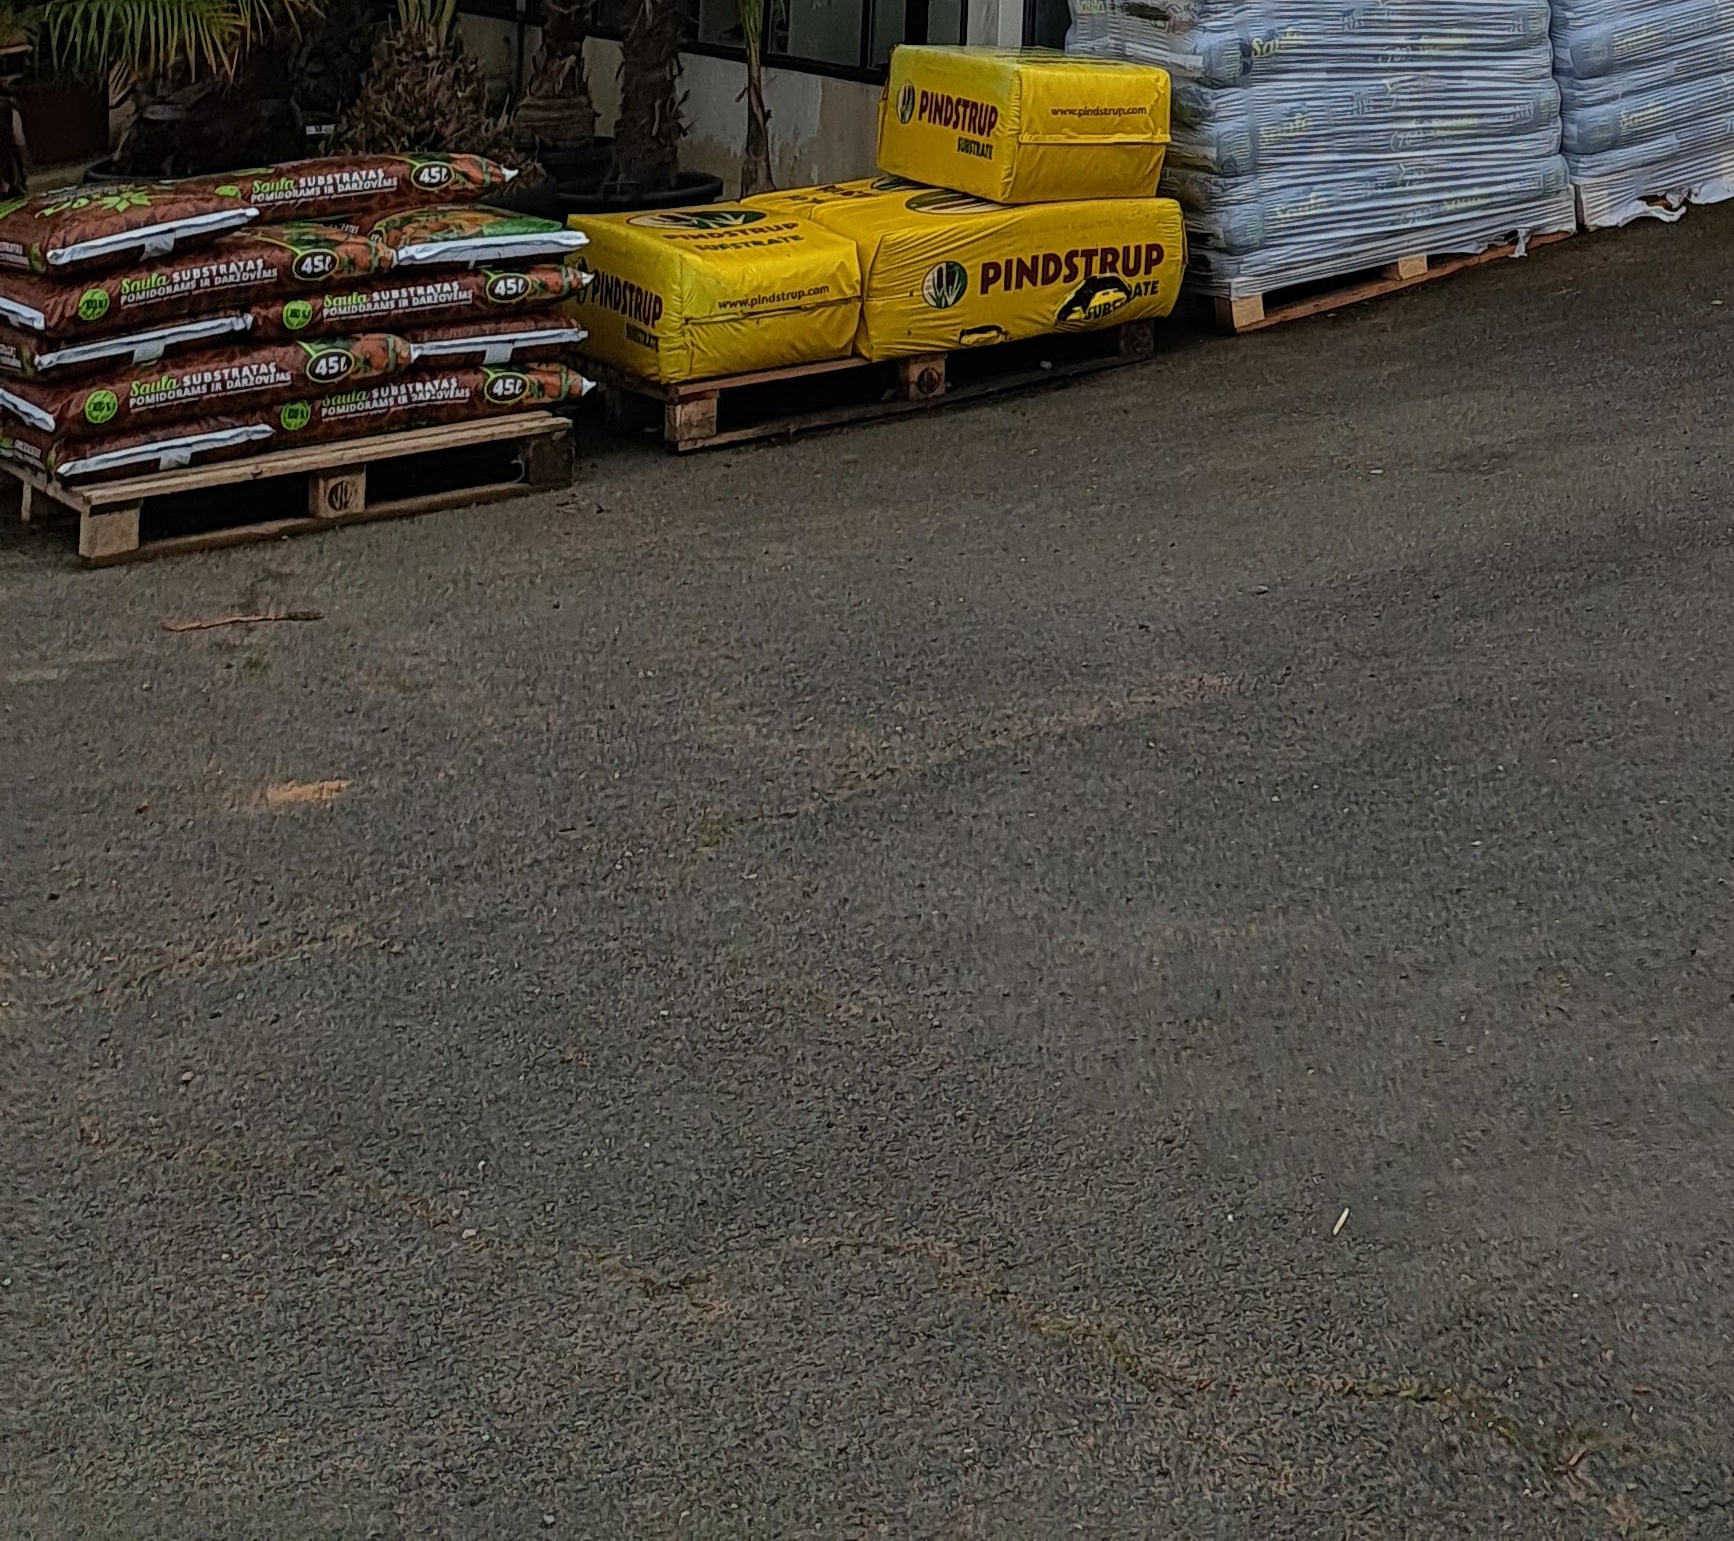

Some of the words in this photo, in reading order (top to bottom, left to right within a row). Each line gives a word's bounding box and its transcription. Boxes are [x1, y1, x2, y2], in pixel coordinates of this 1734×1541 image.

[918, 90, 998, 137] PINDSTRUP
[1051, 105, 1147, 117] www.pindstrup.com
[957, 136, 993, 160] SUBSTRATE
[252, 177, 294, 195] Saula
[299, 168, 385, 188] SUBSTRATAS
[662, 223, 799, 240] PINDSTRUP
[120, 274, 171, 295] Saula
[172, 259, 264, 283] SUBSTRATAS
[980, 243, 1165, 295] PINDSTRUP
[120, 280, 197, 304] POMIDORAMS
[323, 292, 369, 308] Saula
[372, 281, 460, 301] SUBSTRATAS
[591, 269, 663, 329] PINDSTRUP
[718, 284, 830, 309] www.pindstrup.com
[130, 376, 180, 398] Saula
[182, 362, 278, 387] SUBSTRATAS
[372, 378, 458, 398] SUBSTRATAS
[129, 383, 207, 408] POMIDORAMS
[210, 380, 223, 392] IR
[321, 397, 394, 417] POMIDORAMS
